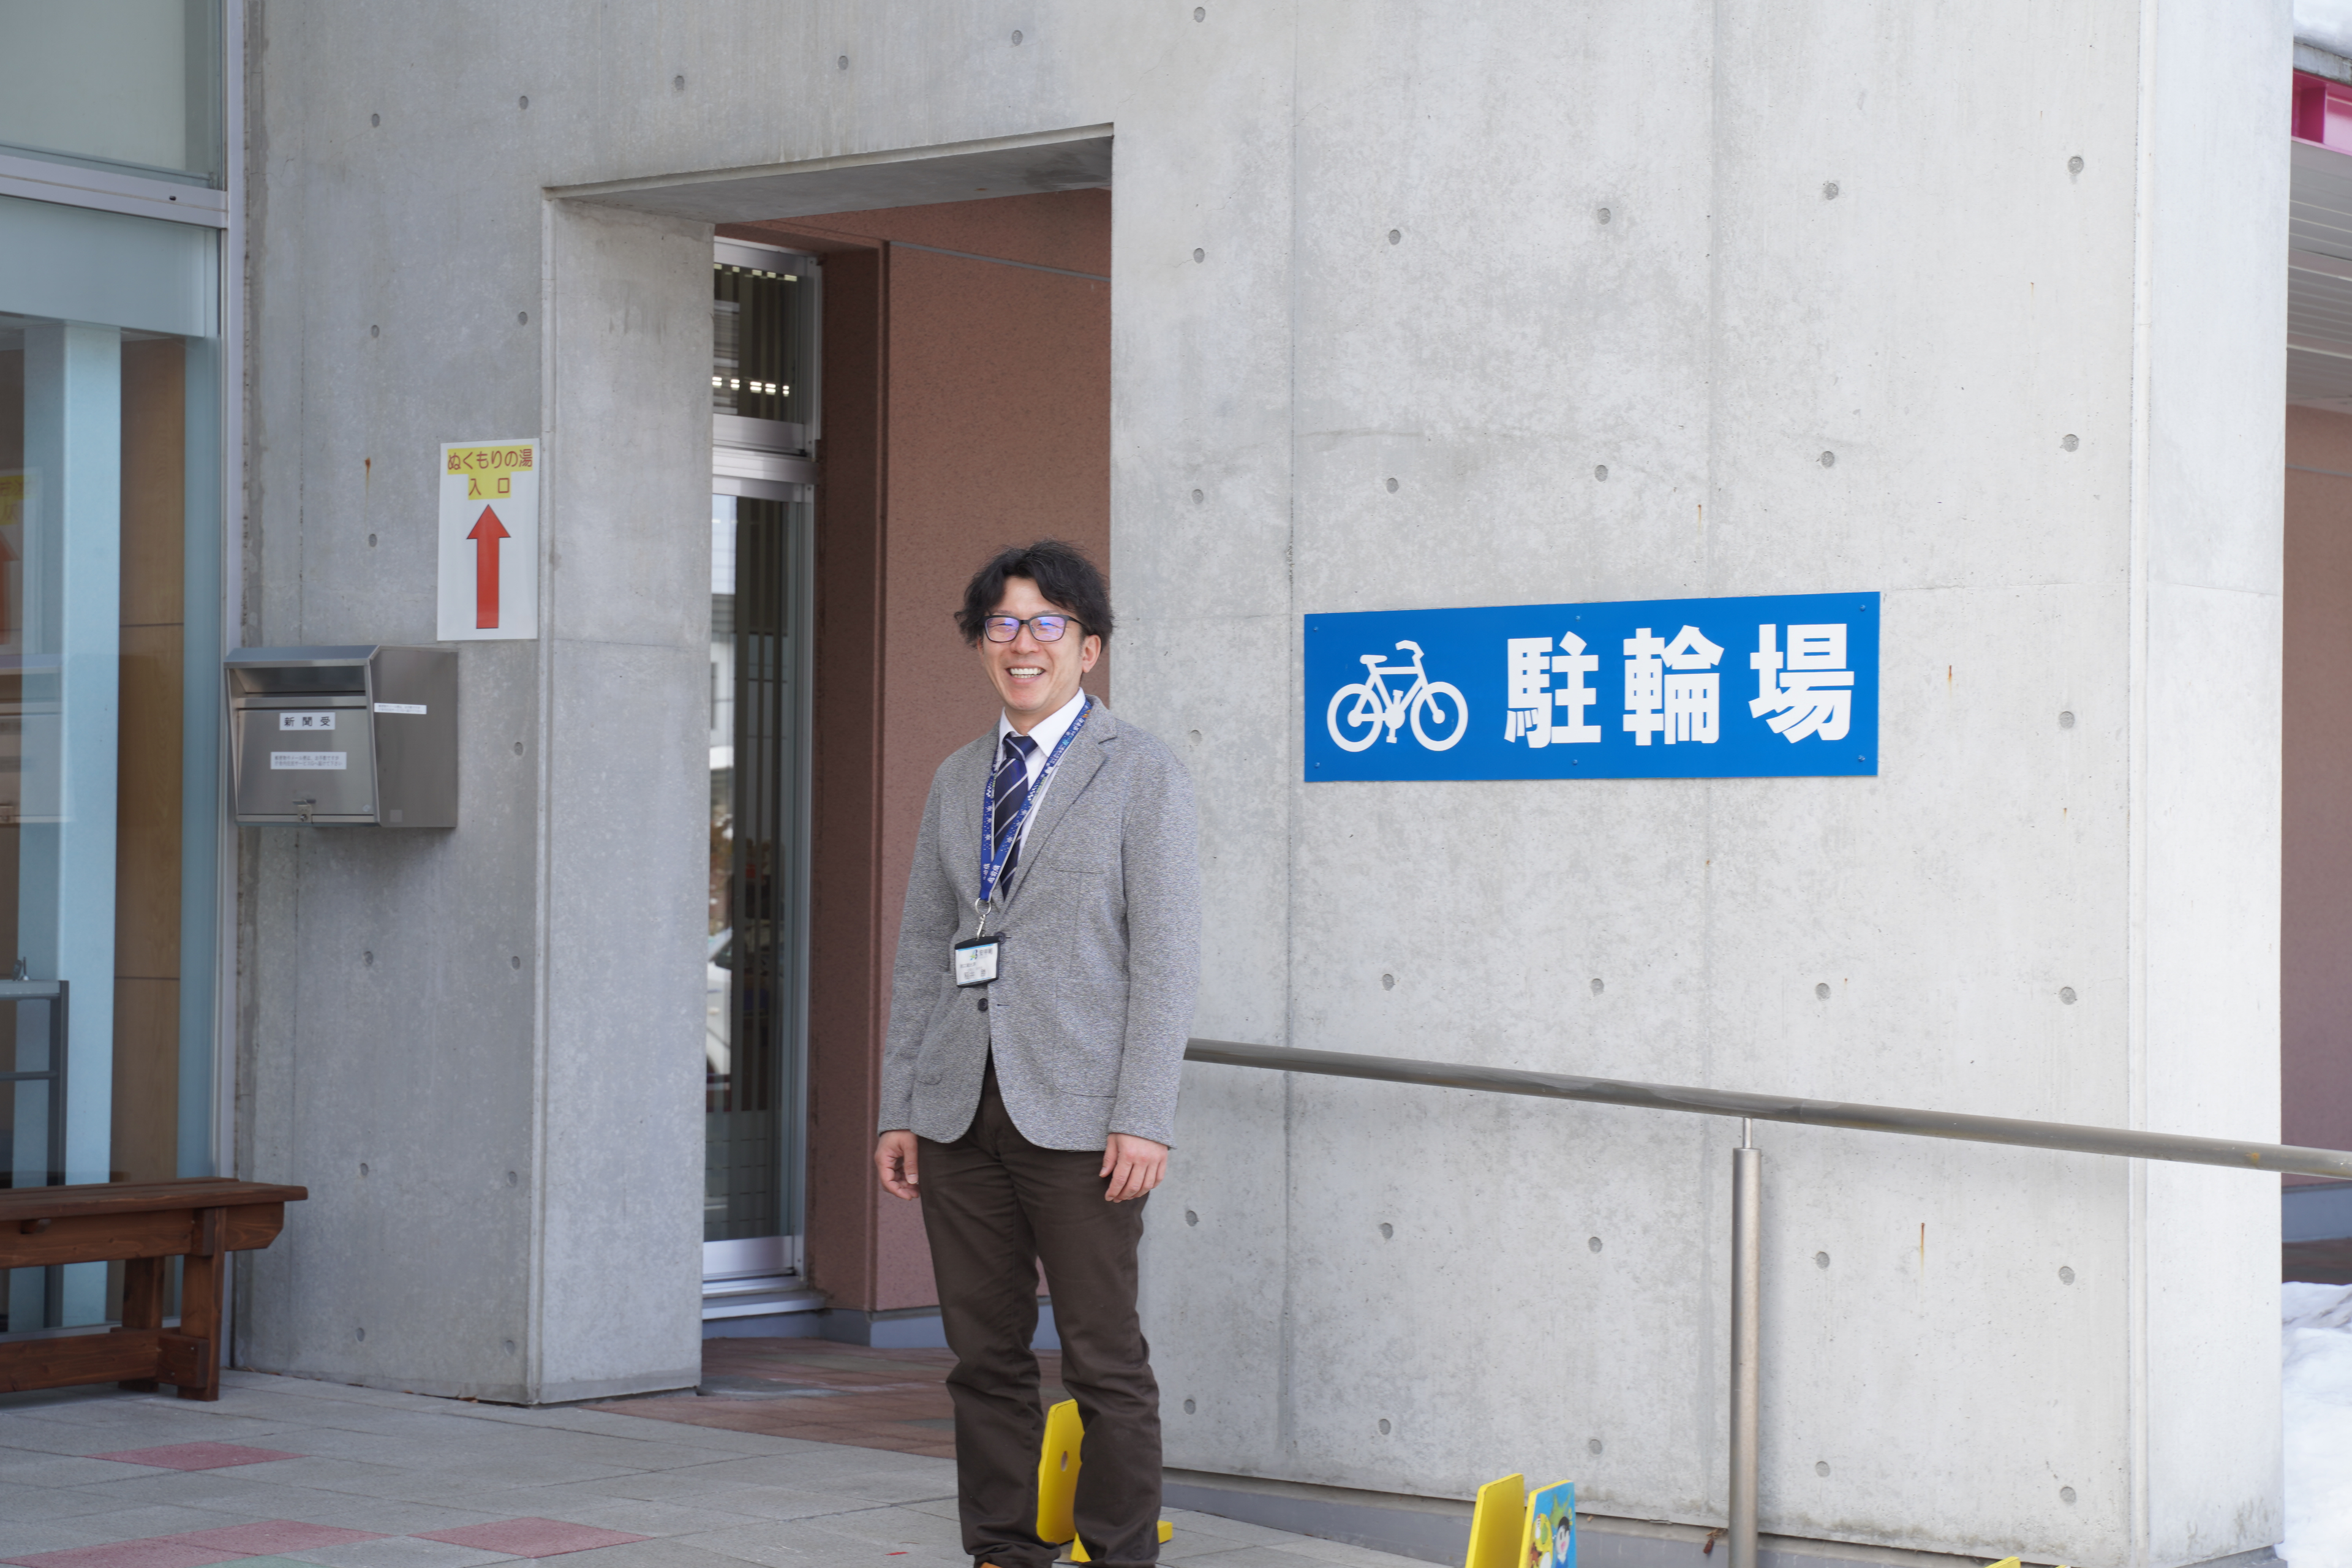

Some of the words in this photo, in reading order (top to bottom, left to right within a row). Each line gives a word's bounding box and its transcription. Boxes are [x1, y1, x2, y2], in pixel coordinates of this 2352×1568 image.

[448, 448, 533, 470] ぬくもりの湯
[469, 477, 510, 496] 入口
[1504, 624, 1855, 748] 駐輪場
[284, 716, 331, 727] 新聞受
